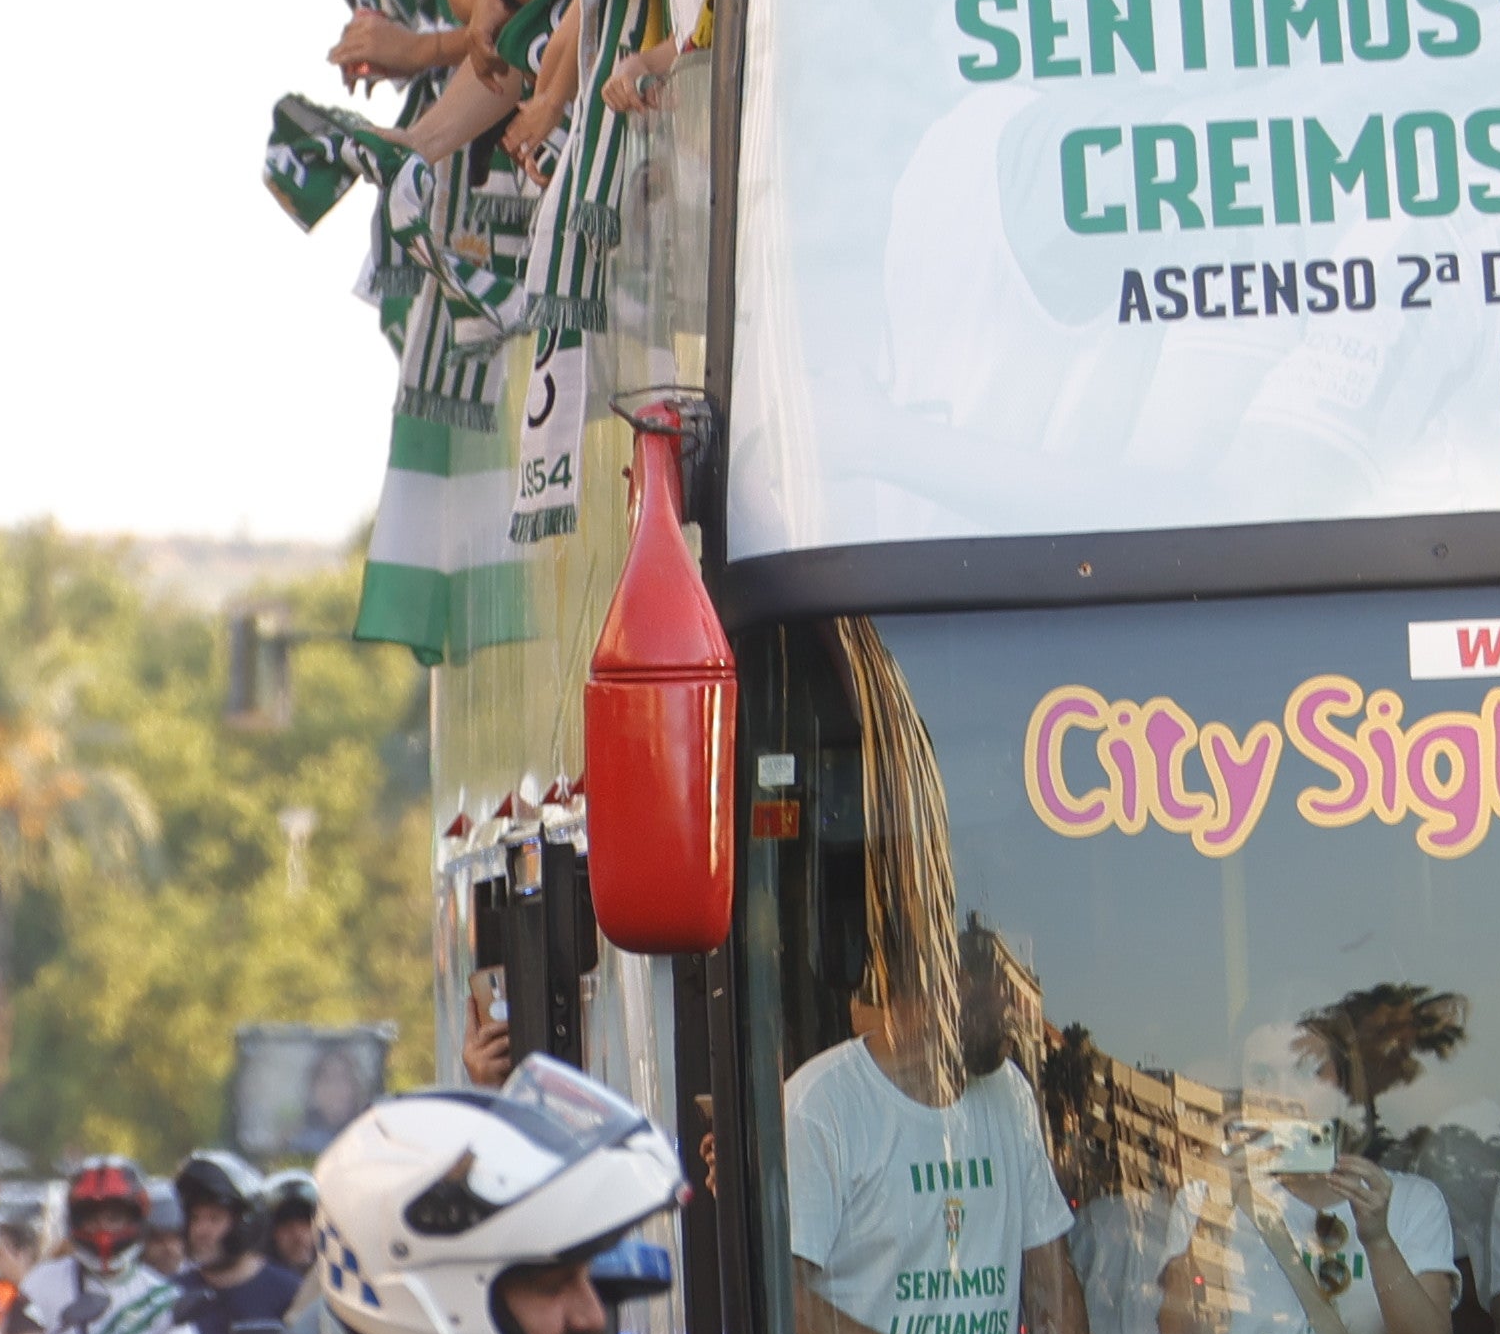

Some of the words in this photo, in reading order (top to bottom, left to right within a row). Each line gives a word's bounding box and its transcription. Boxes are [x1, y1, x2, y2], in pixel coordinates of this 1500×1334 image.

[1118, 258, 1377, 323] ASCENSO
[1396, 254, 1461, 310] 2ª
[520, 451, 573, 498] 1954
[895, 1266, 1007, 1301] SENTIMOS
